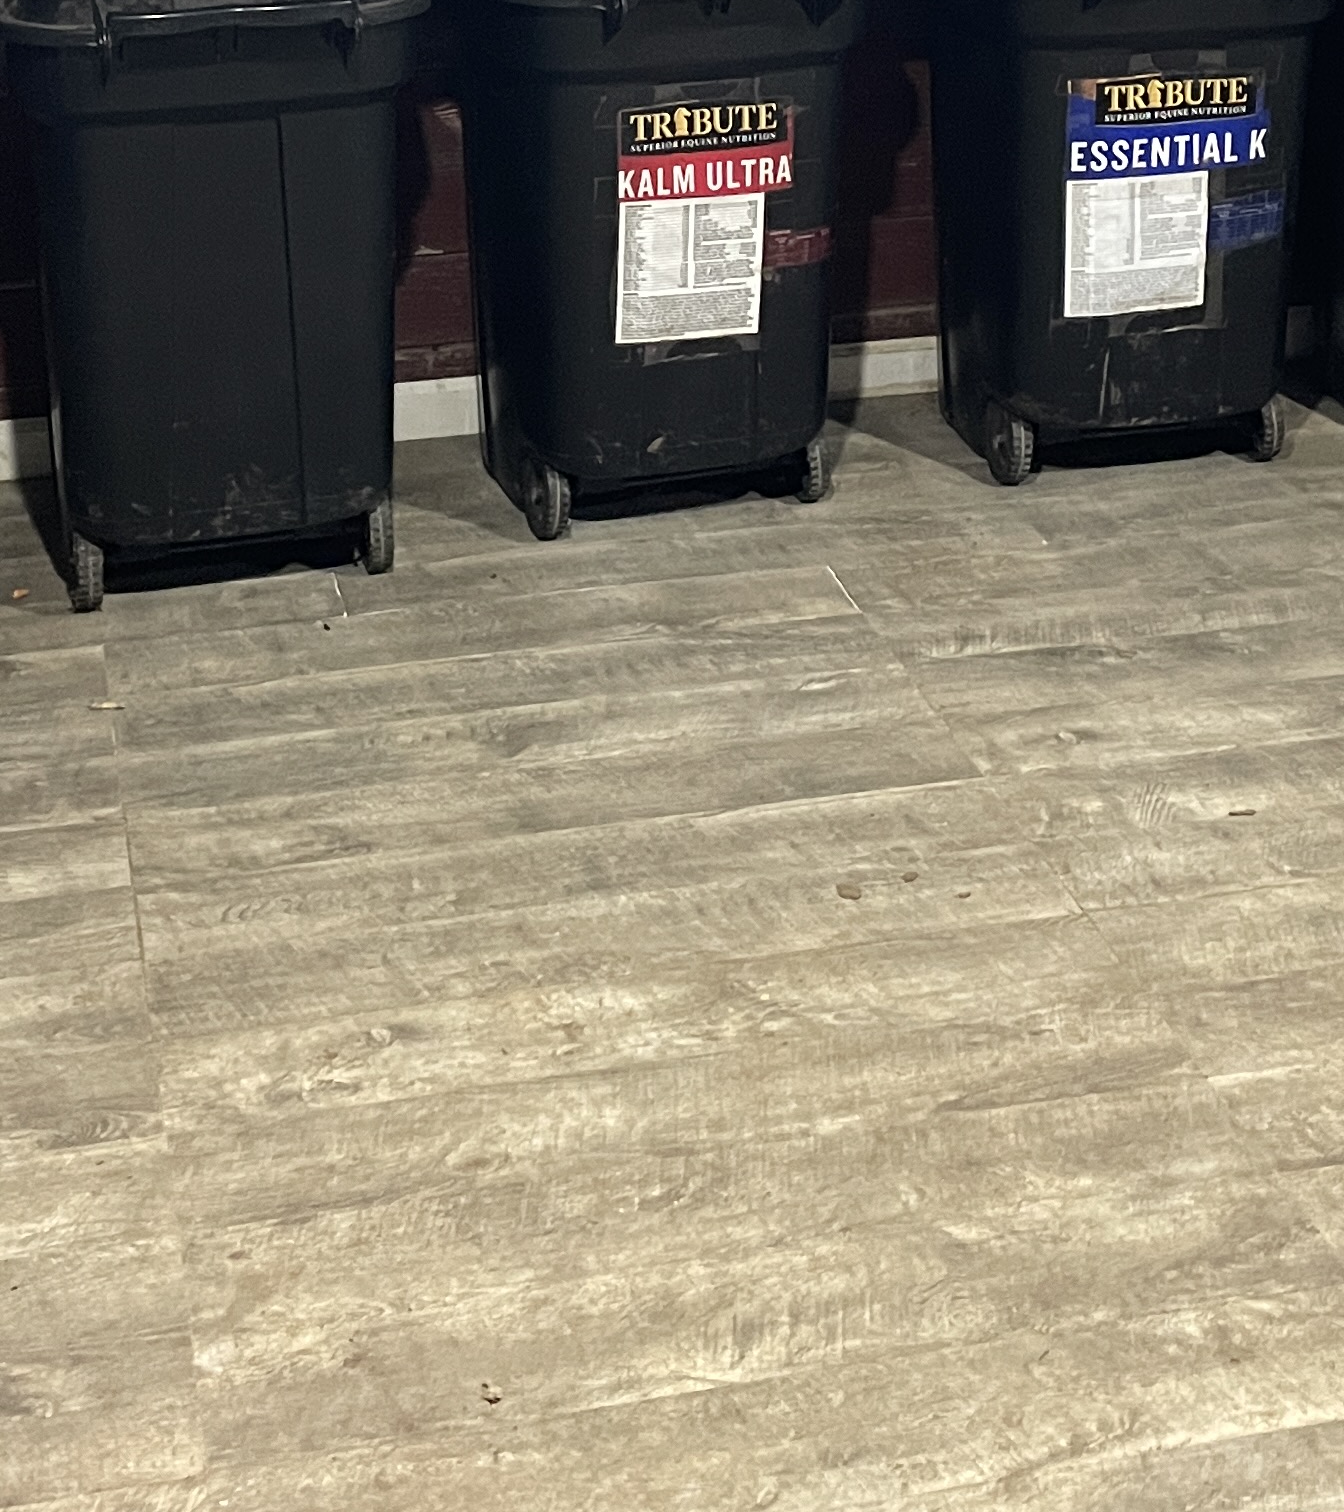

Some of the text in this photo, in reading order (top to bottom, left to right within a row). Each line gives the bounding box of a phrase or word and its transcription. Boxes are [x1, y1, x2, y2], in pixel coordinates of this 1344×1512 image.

[1104, 76, 1249, 113] TRIBUTE
[1104, 104, 1247, 123] SUPERIOR EQUINE NUTRITION
[630, 101, 779, 143] TRIBUTE
[630, 131, 777, 153] SUPERIOR EQUINE NUTRITION
[1070, 128, 1267, 172] ESSENTIAL K
[618, 155, 792, 199] KALM ULTRA
